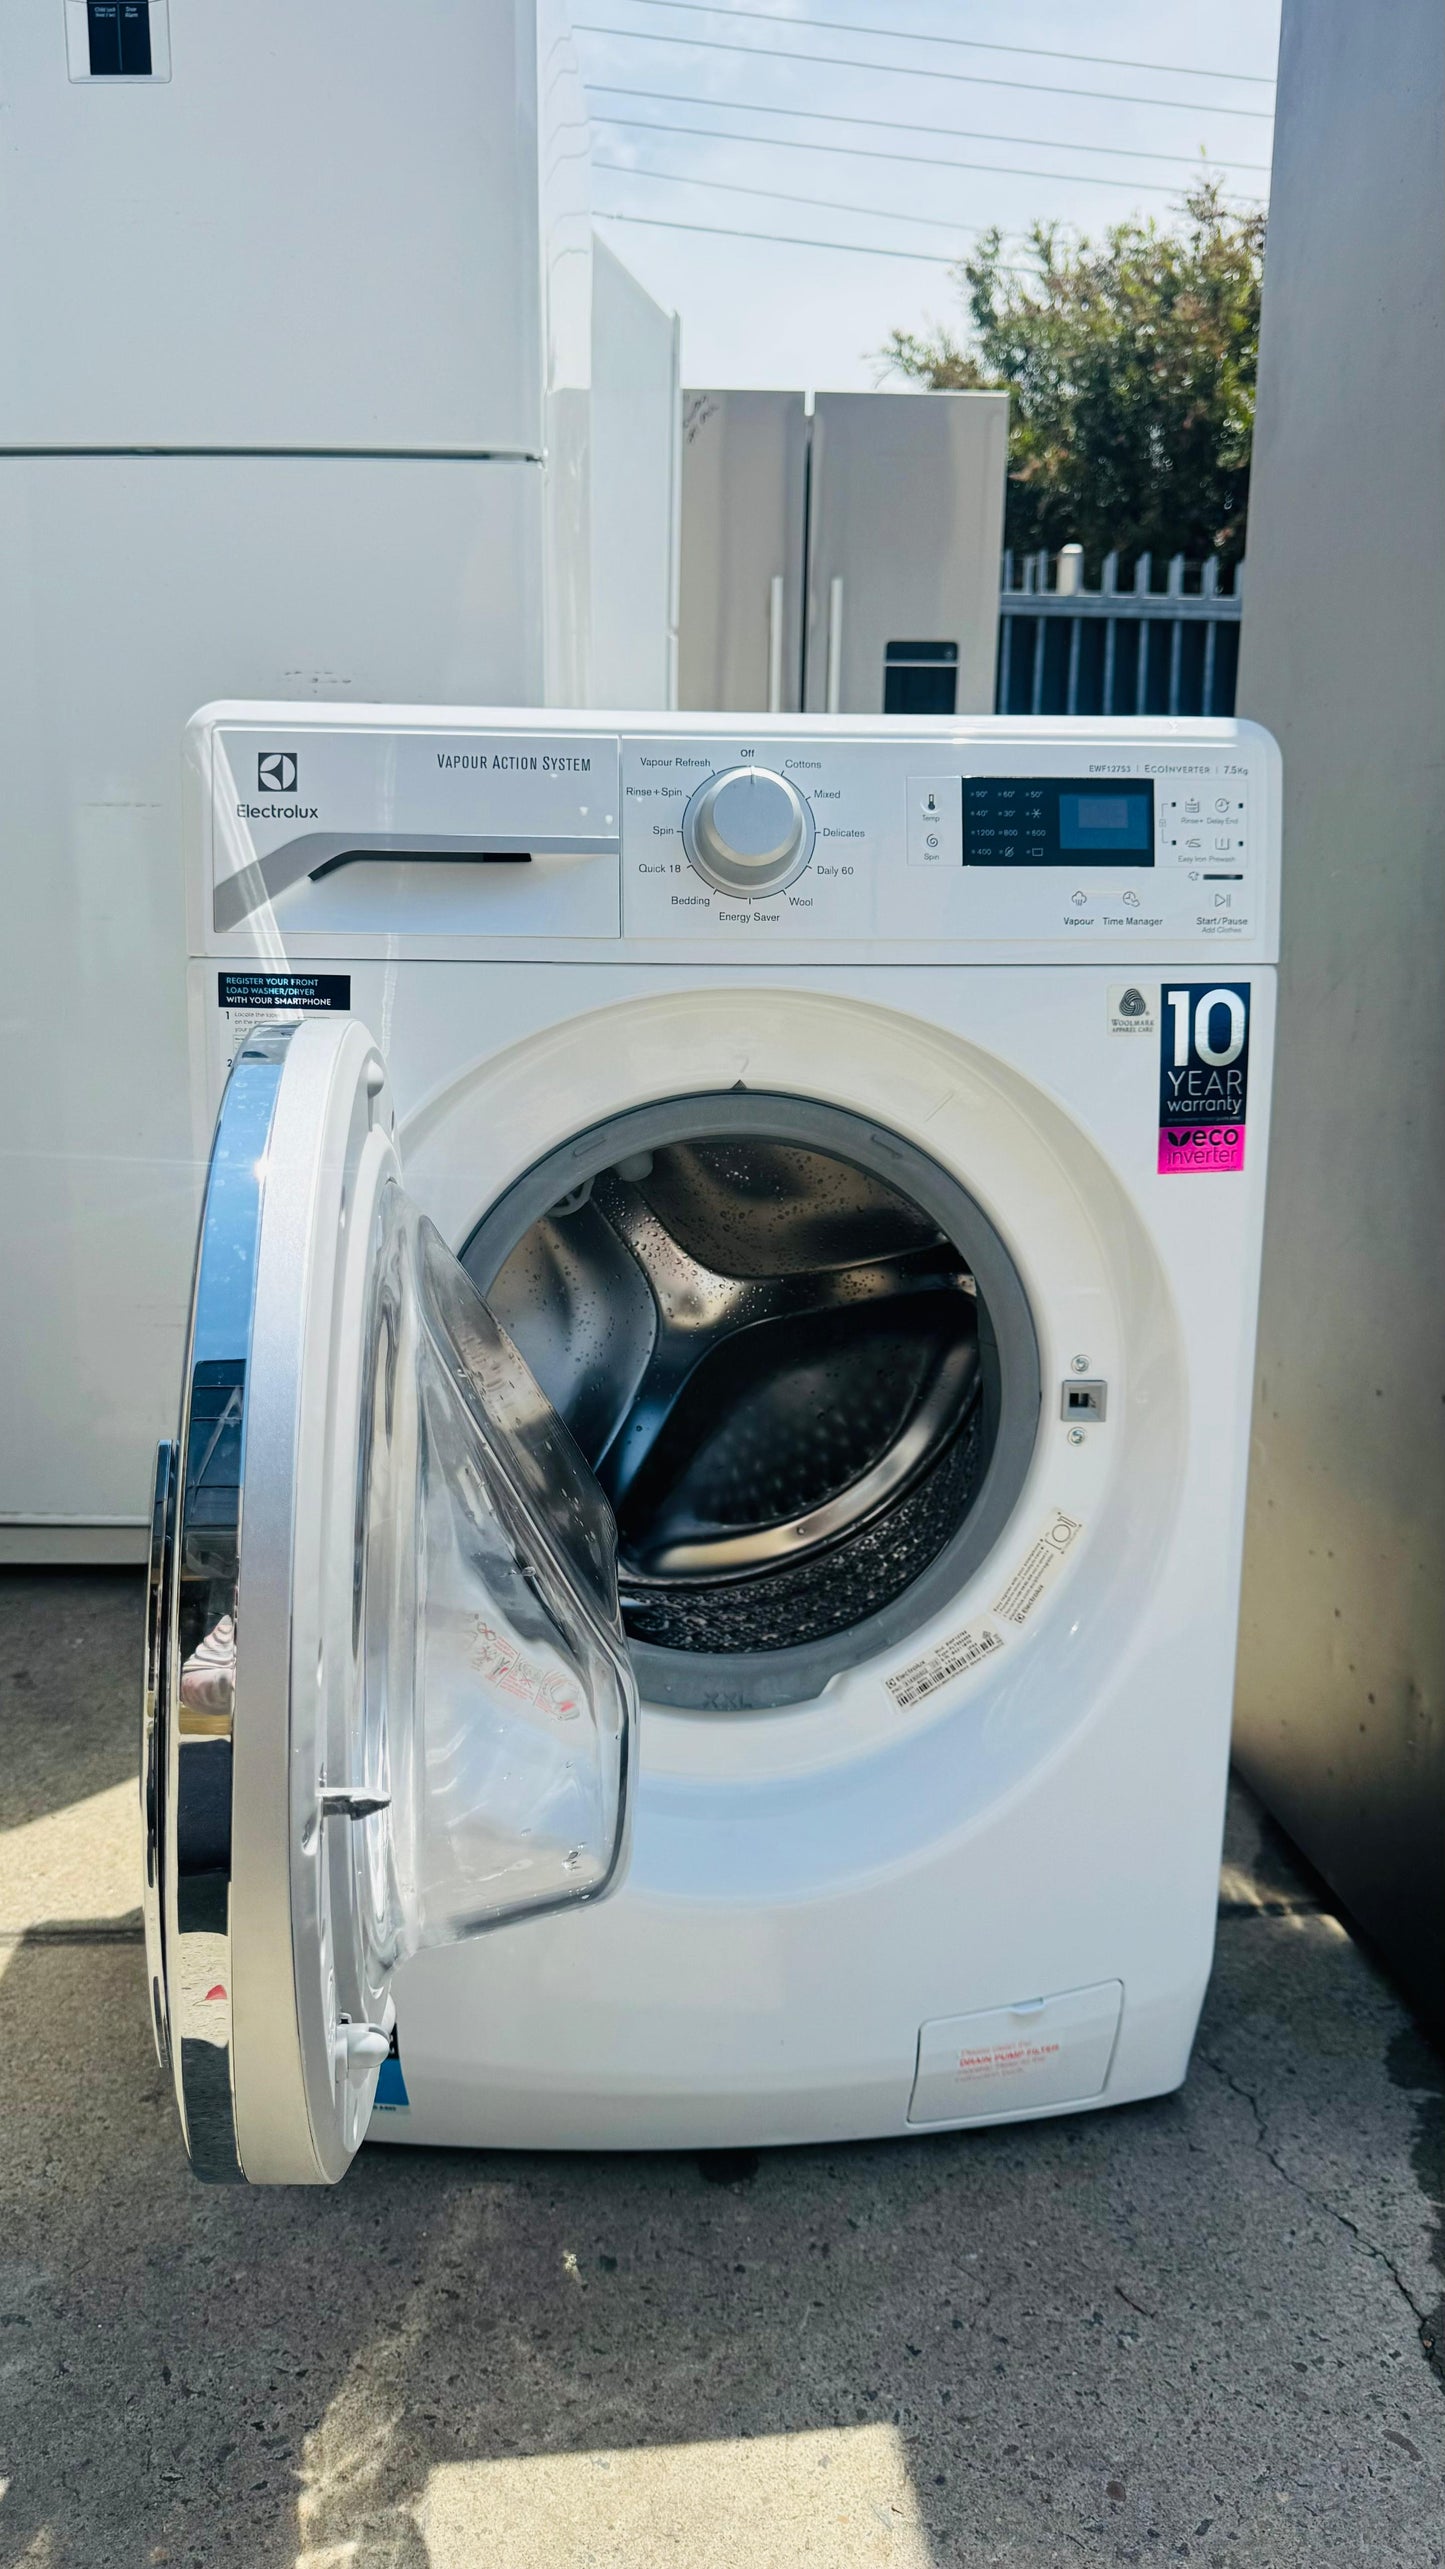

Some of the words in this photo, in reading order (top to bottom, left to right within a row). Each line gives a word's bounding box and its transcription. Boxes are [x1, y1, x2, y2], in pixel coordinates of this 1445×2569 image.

[740, 749, 755, 758] Off
[437, 753, 488, 769] VAPOUR
[492, 754, 537, 770] ACTION
[542, 755, 591, 771] SYSTEM
[640, 758, 672, 768] Vapour
[675, 757, 711, 767] Refresh
[785, 759, 822, 769] Cottons
[814, 790, 841, 799] Mixed
[236, 804, 319, 819] Electrolux
[922, 814, 940, 823] Temp
[652, 826, 674, 836] Spin
[822, 828, 865, 838] Delicates
[923, 853, 939, 861] Spin
[638, 864, 666, 874] Quick
[669, 864, 681, 873] 18
[817, 866, 839, 876] Daily
[841, 866, 854, 875] 60
[671, 896, 710, 907] Bedding
[789, 897, 814, 907] Wool
[719, 912, 751, 923] Energy
[753, 913, 780, 922] Saver
[1063, 917, 1094, 926] Vapour
[1102, 917, 1124, 926] Time
[1125, 917, 1163, 927] Manager
[1196, 917, 1248, 926] Start/Pause
[226, 977, 264, 985] REGISTER
[266, 978, 289, 986] YOUR
[291, 979, 319, 987] FRONT
[250, 987, 315, 996] WASHER/DRYER
[226, 996, 248, 1004] WITH
[249, 996, 273, 1004] YOUR
[274, 997, 332, 1006] SMARTPHONE
[225, 1011, 230, 1020] 1
[1167, 988, 1246, 1067] 10
[1167, 1070, 1243, 1097] YEAR
[1167, 1096, 1242, 1115] warranty
[1191, 1128, 1239, 1147] eco
[1167, 1147, 1238, 1165] inverter
[703, 1692, 753, 1709] XXL
